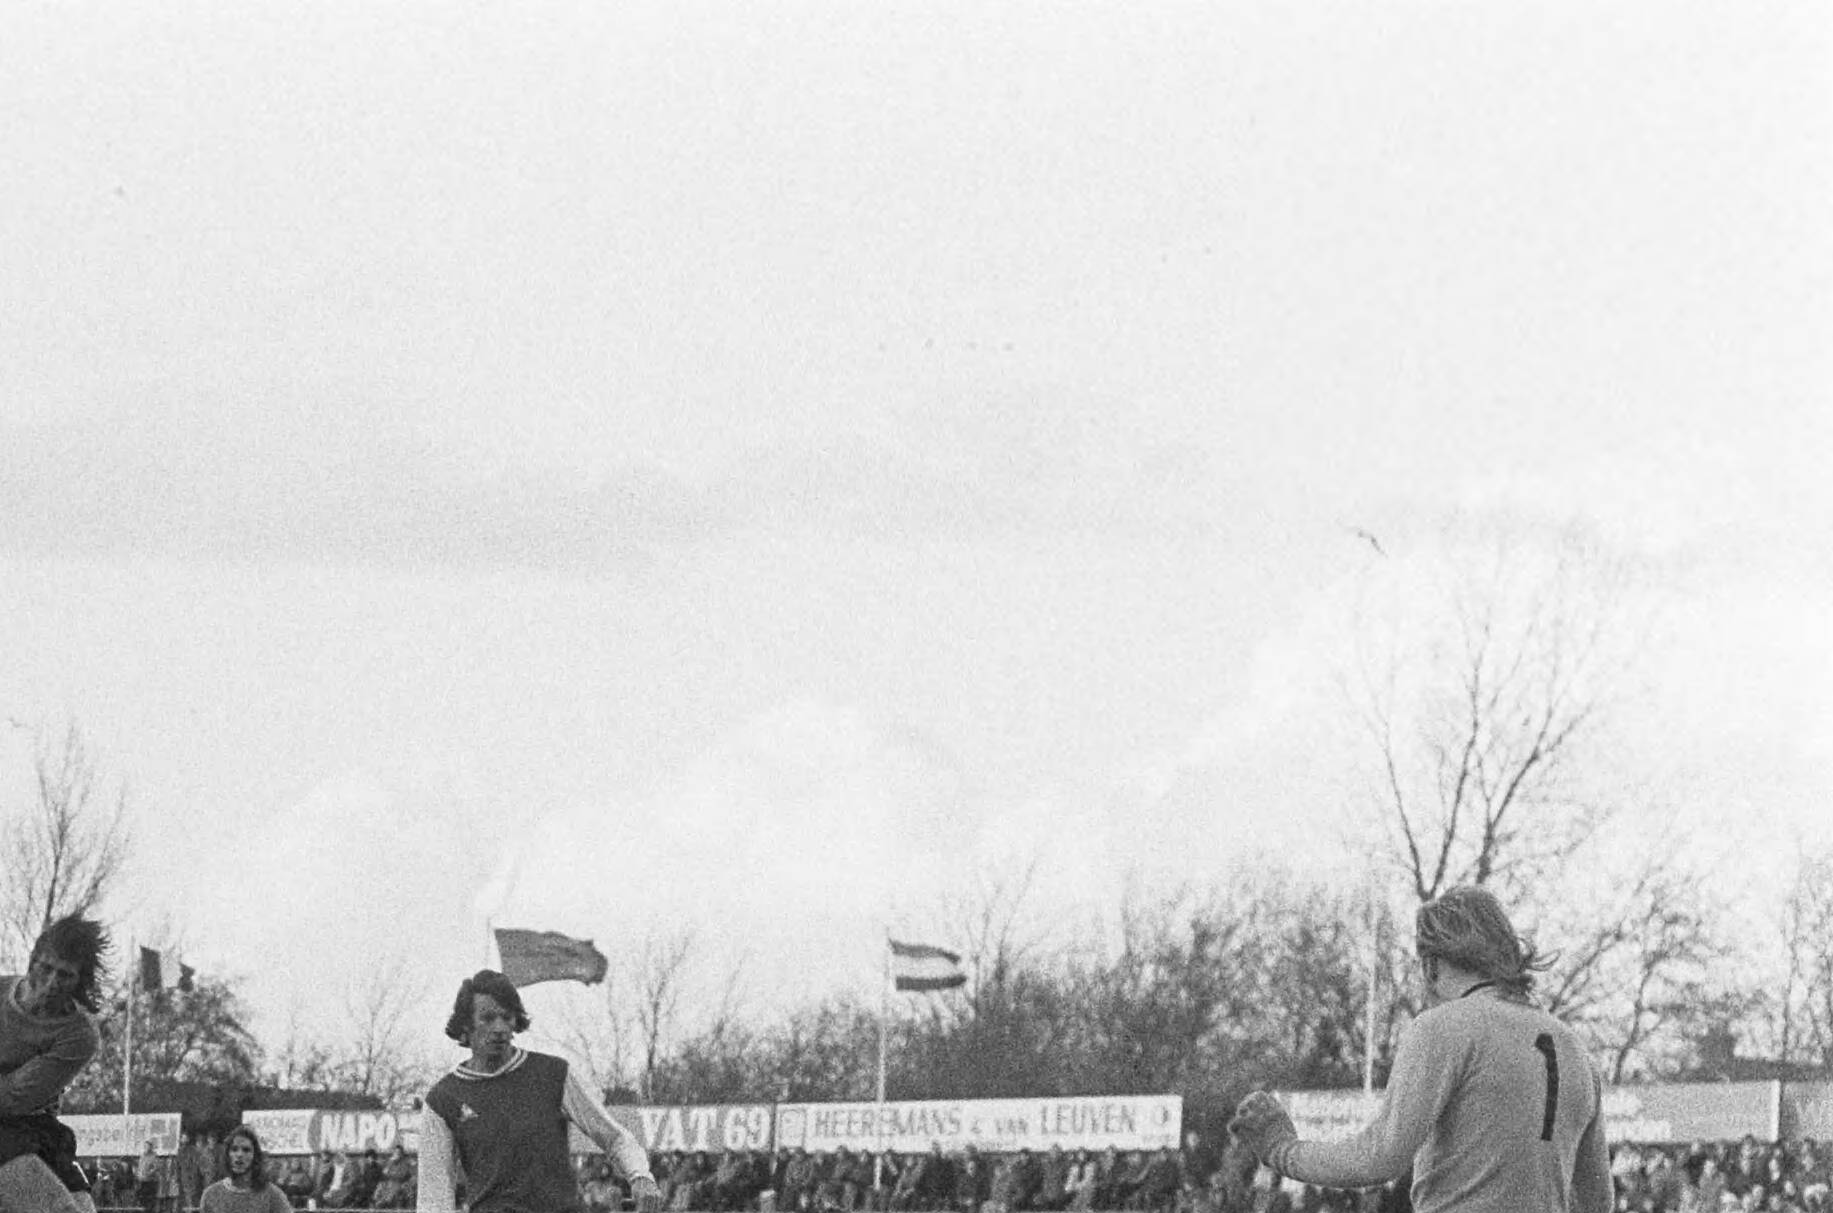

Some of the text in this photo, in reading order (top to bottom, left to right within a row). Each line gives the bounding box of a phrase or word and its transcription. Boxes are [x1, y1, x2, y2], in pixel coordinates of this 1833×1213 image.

[1534, 1032, 1560, 1141] 1
[638, 1107, 770, 1150] VAT 69
[1041, 1104, 1136, 1135] LEUVEN
